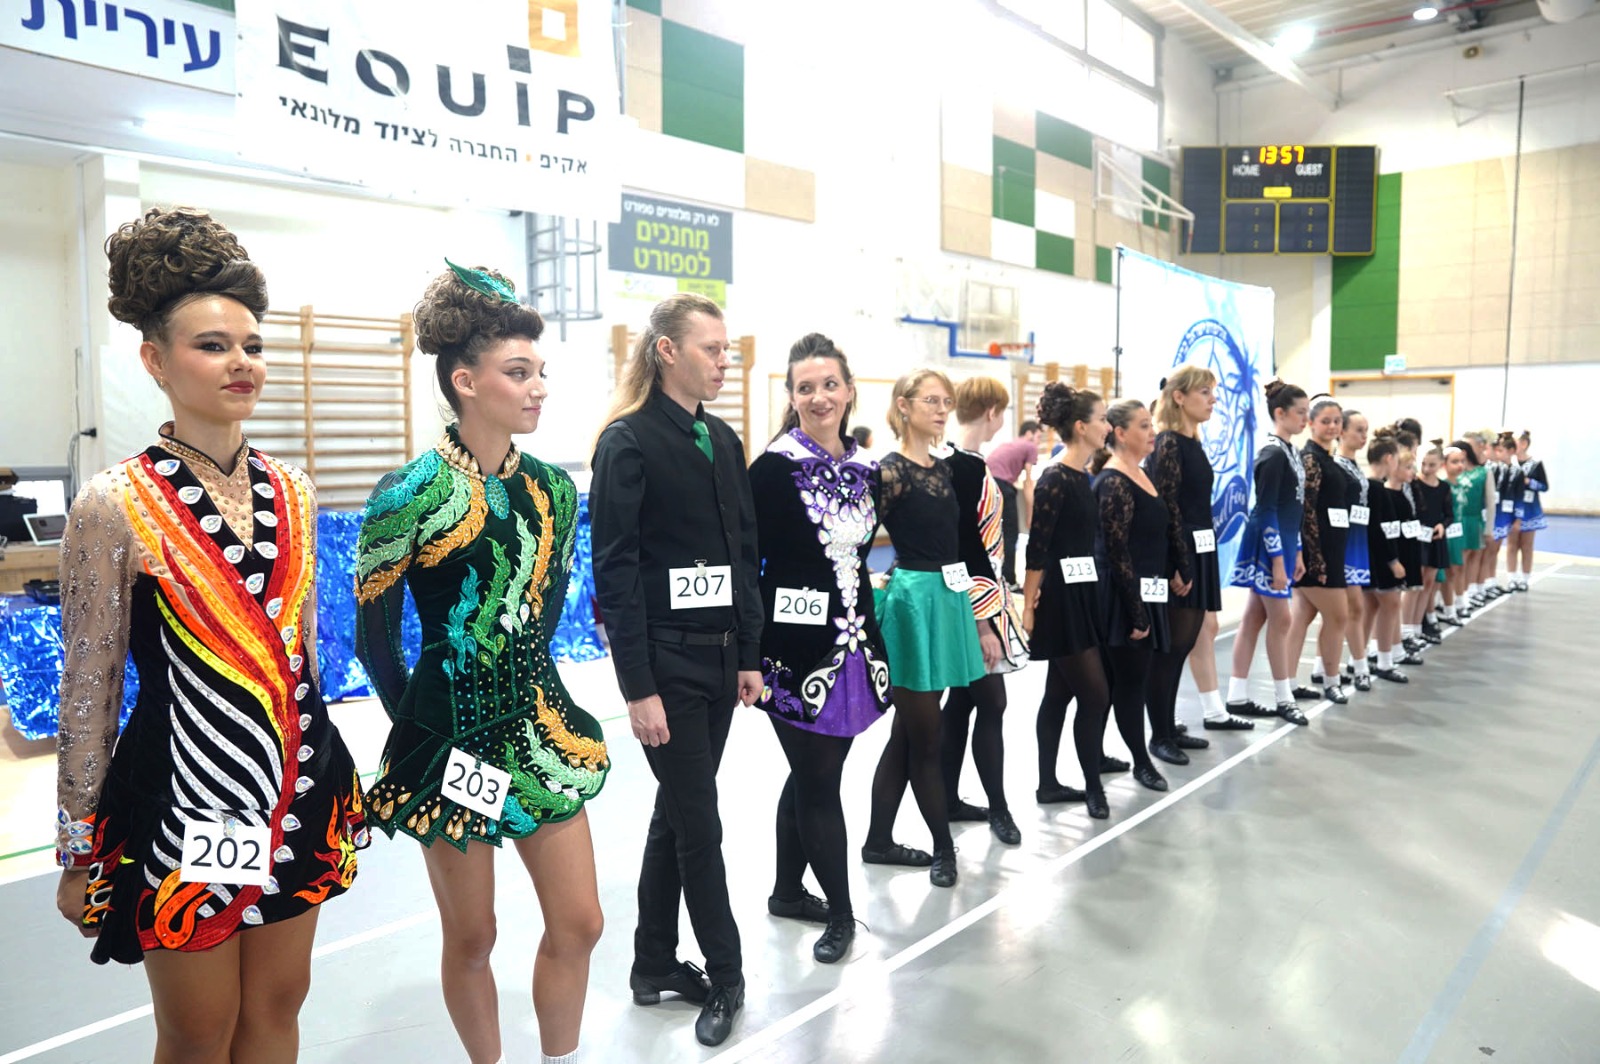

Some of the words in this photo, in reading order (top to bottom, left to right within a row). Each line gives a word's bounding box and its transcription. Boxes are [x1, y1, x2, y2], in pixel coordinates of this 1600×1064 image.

[21, 0, 221, 73] עיריית
[279, 95, 361, 135] מלונאי
[374, 121, 438, 148] לציוד
[449, 138, 518, 163] החברה
[1232, 164, 1260, 177] HOME
[1295, 163, 1323, 176] GUEST
[636, 219, 709, 251] מחנכים
[633, 246, 711, 277] לספורט
[1198, 534, 1214, 548] 212
[1065, 561, 1094, 577] 213
[676, 574, 725, 598] 207
[1143, 581, 1166, 596] 223
[779, 595, 822, 616] 206
[447, 761, 501, 806] 203
[190, 834, 261, 871] 202
